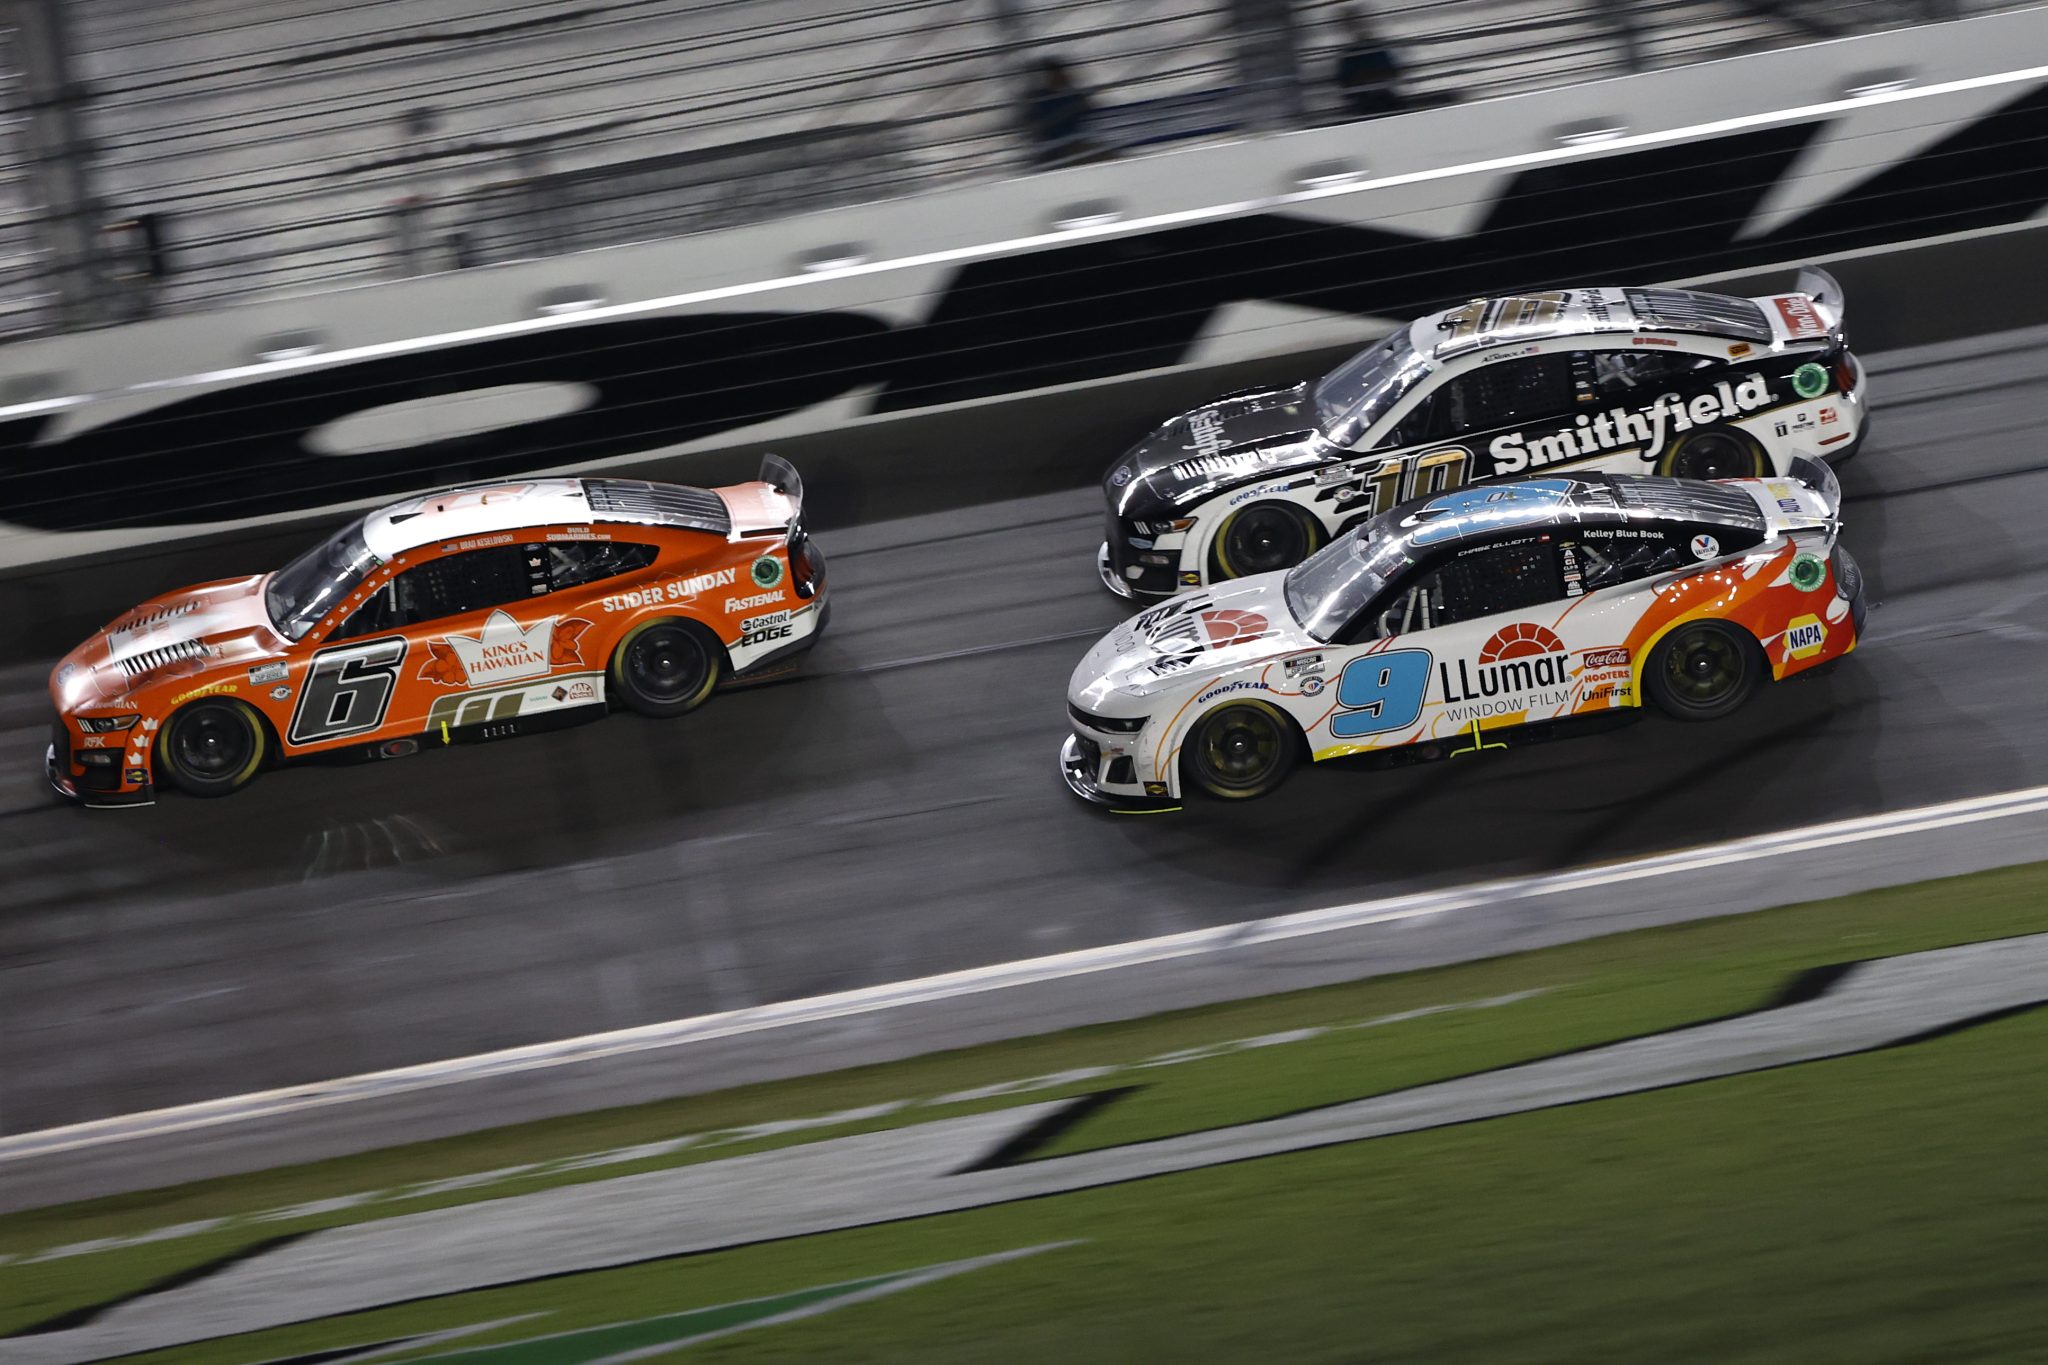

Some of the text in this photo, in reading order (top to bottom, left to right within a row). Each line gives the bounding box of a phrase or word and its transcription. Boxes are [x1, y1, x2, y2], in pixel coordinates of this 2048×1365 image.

[1489, 373, 1772, 475] Smithfield
[1361, 445, 1475, 519] 10
[477, 534, 513, 549] KESELOWSKI
[1584, 530, 1665, 540] Kelley Blue Book
[1457, 537, 1536, 557] CHASE ELLIOTT
[603, 586, 664, 612] SLIDER
[667, 568, 736, 599] SUNDAY
[724, 590, 786, 614] FASTENAL
[752, 612, 787, 629] Castrol
[741, 624, 793, 647] EDGE
[1790, 624, 1822, 649] NAPA
[482, 640, 528, 659] KING'S
[470, 651, 544, 673] HAWAIIAN
[1440, 653, 1569, 703] LLumar
[1584, 670, 1630, 683] HOOTERS
[287, 634, 410, 748] 6
[1198, 680, 1269, 703] GOODYEAR
[1330, 648, 1433, 739] 9
[1582, 686, 1632, 701] UniFirst
[1446, 689, 1569, 722] WINDOW FILM
